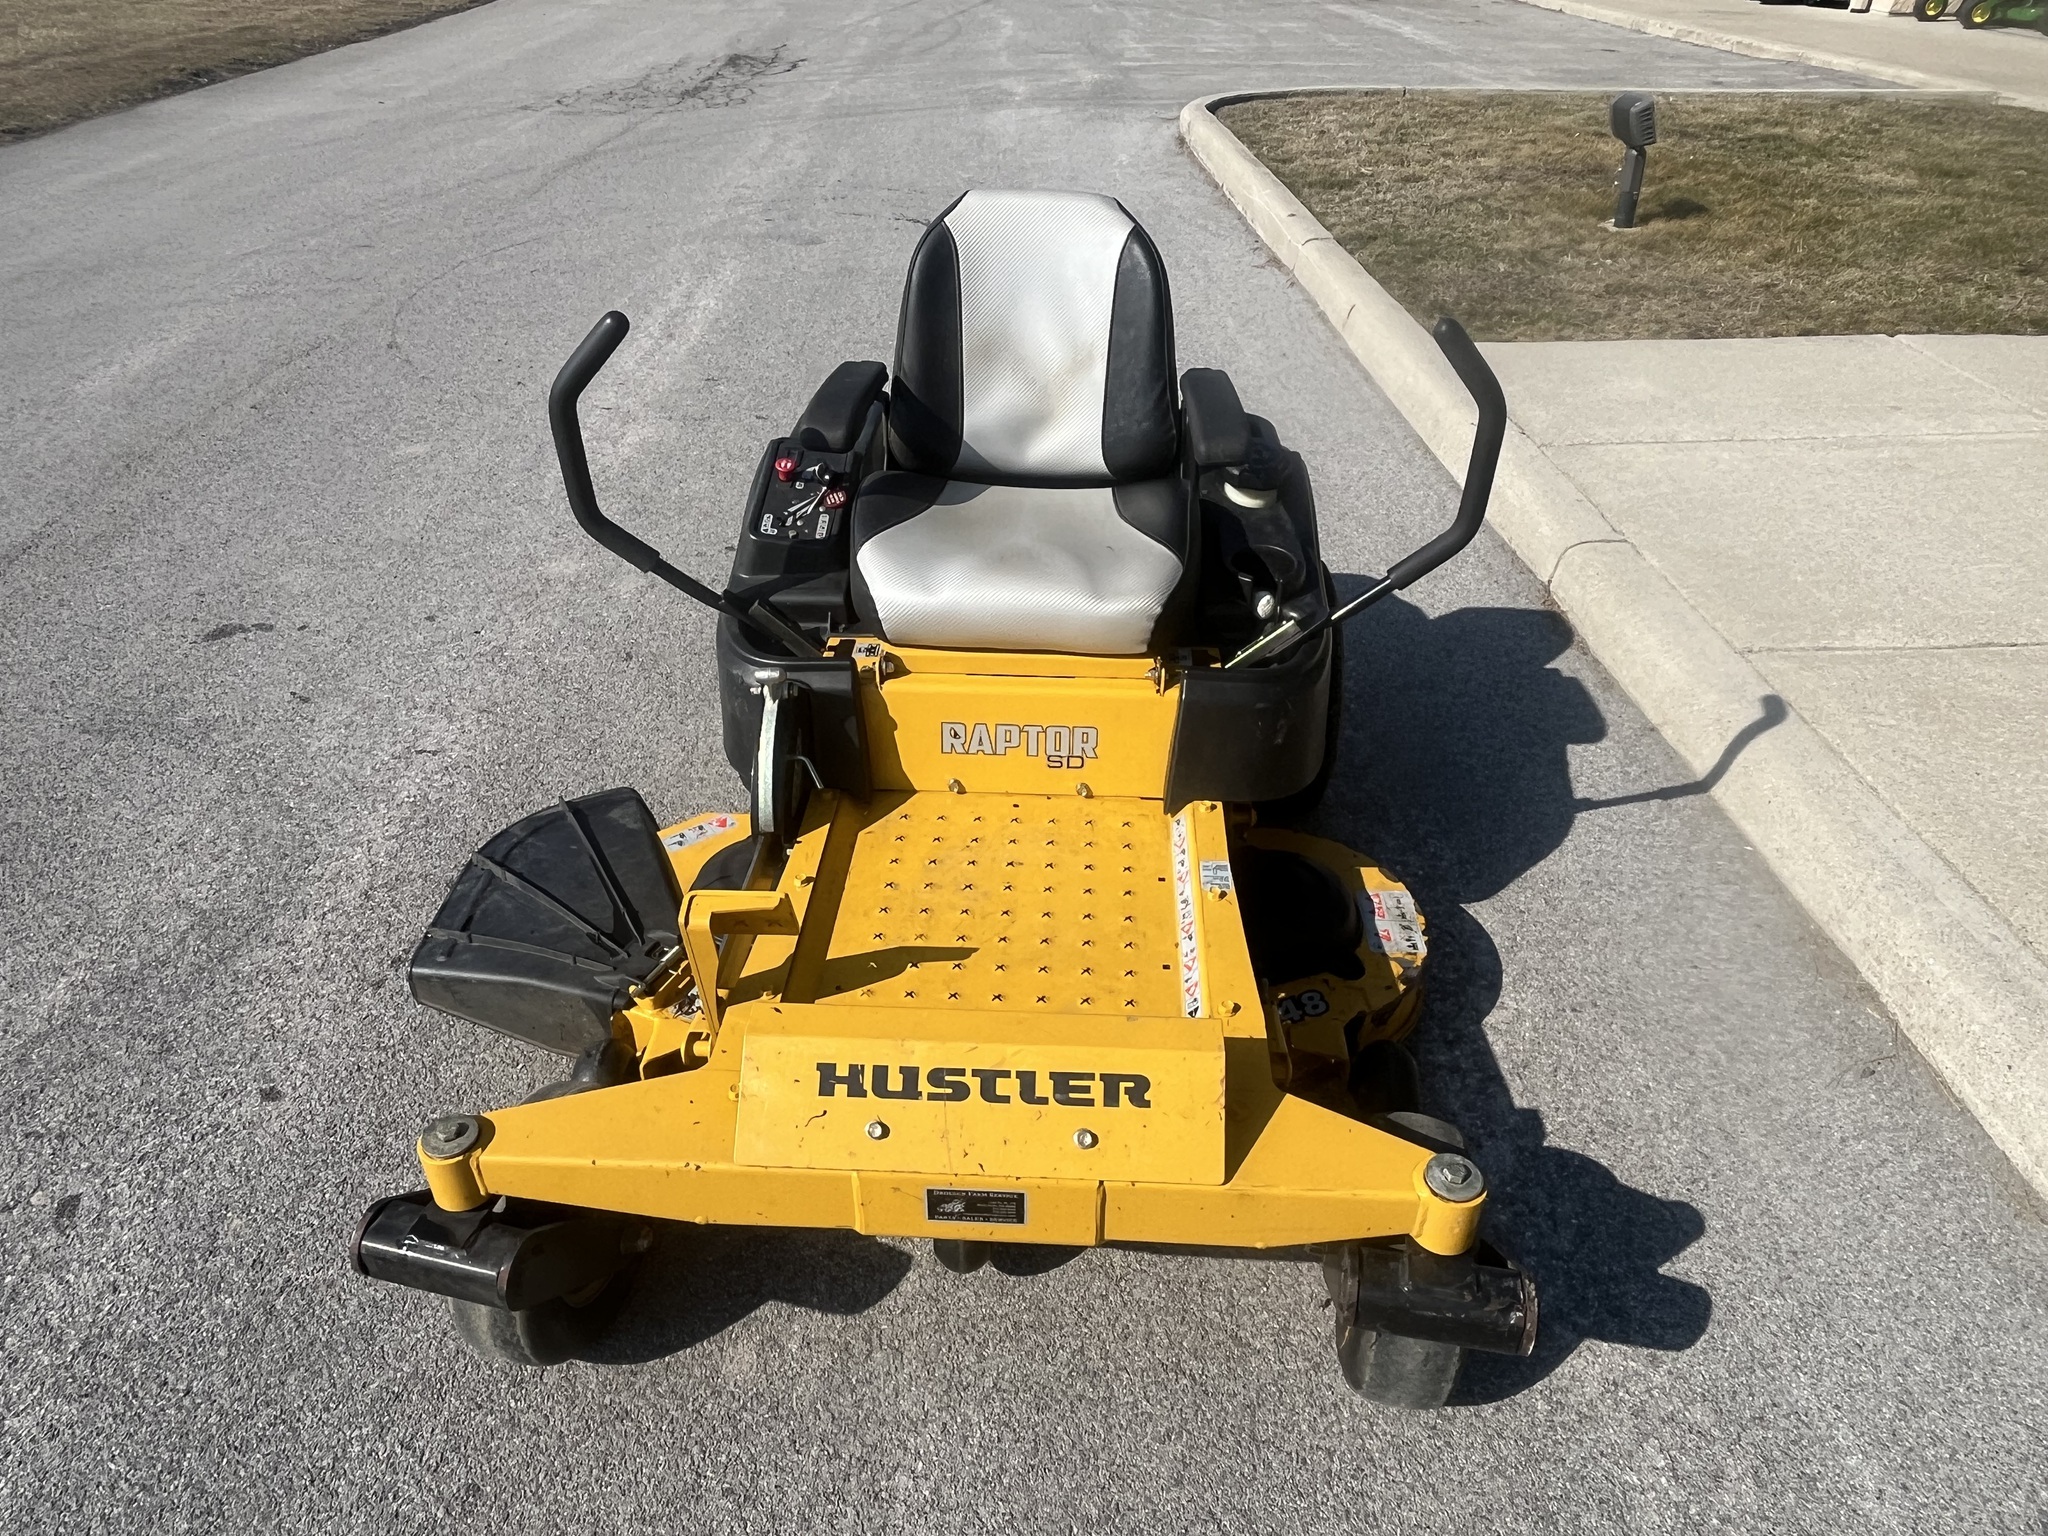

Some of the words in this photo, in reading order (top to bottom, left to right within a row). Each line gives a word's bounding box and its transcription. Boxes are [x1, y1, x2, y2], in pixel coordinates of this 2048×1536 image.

[941, 722, 1098, 759] RAPTOR
[1047, 755, 1084, 769] SD
[1277, 989, 1330, 1022] 48
[816, 1062, 1152, 1108] HUSTLER
